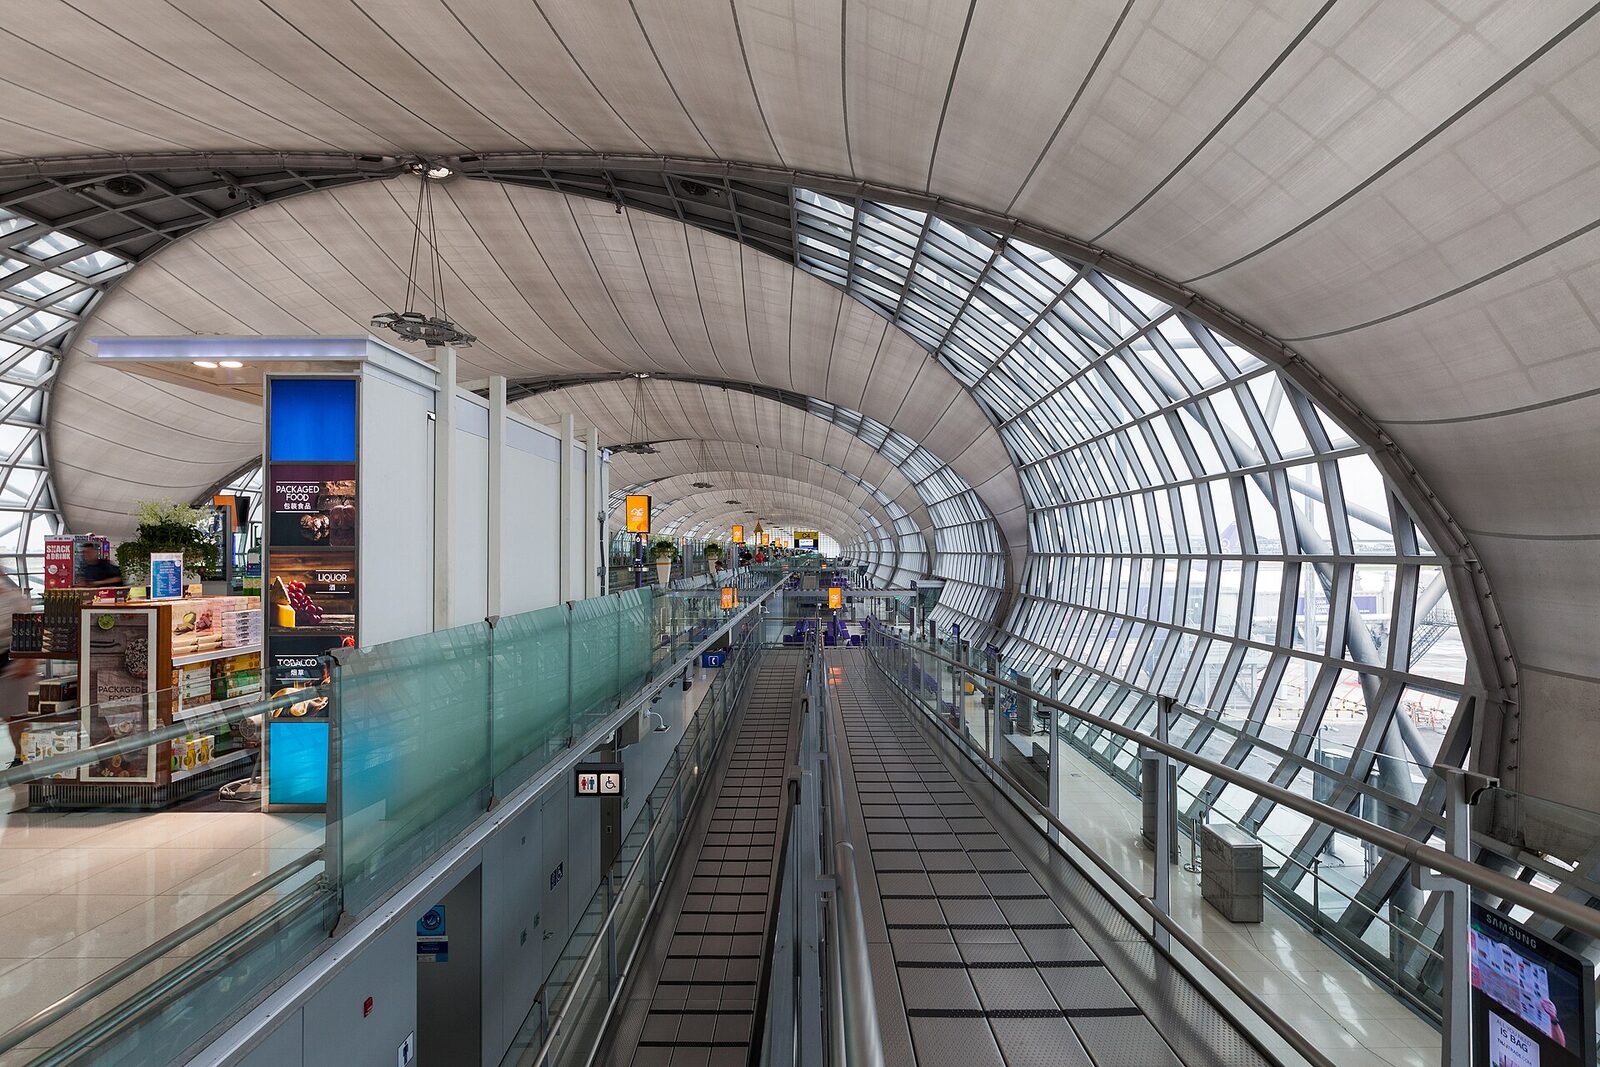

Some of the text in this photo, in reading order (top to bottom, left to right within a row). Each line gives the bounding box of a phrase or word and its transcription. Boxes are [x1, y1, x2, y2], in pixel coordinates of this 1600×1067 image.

[276, 485, 320, 493] PACKAGED
[286, 493, 309, 502] FOOD
[318, 573, 347, 583] LIQUOR
[277, 658, 318, 667] TOBACCO
[1485, 914, 1537, 949] SAMSUNG
[1500, 1027, 1529, 1053] IS BAG
